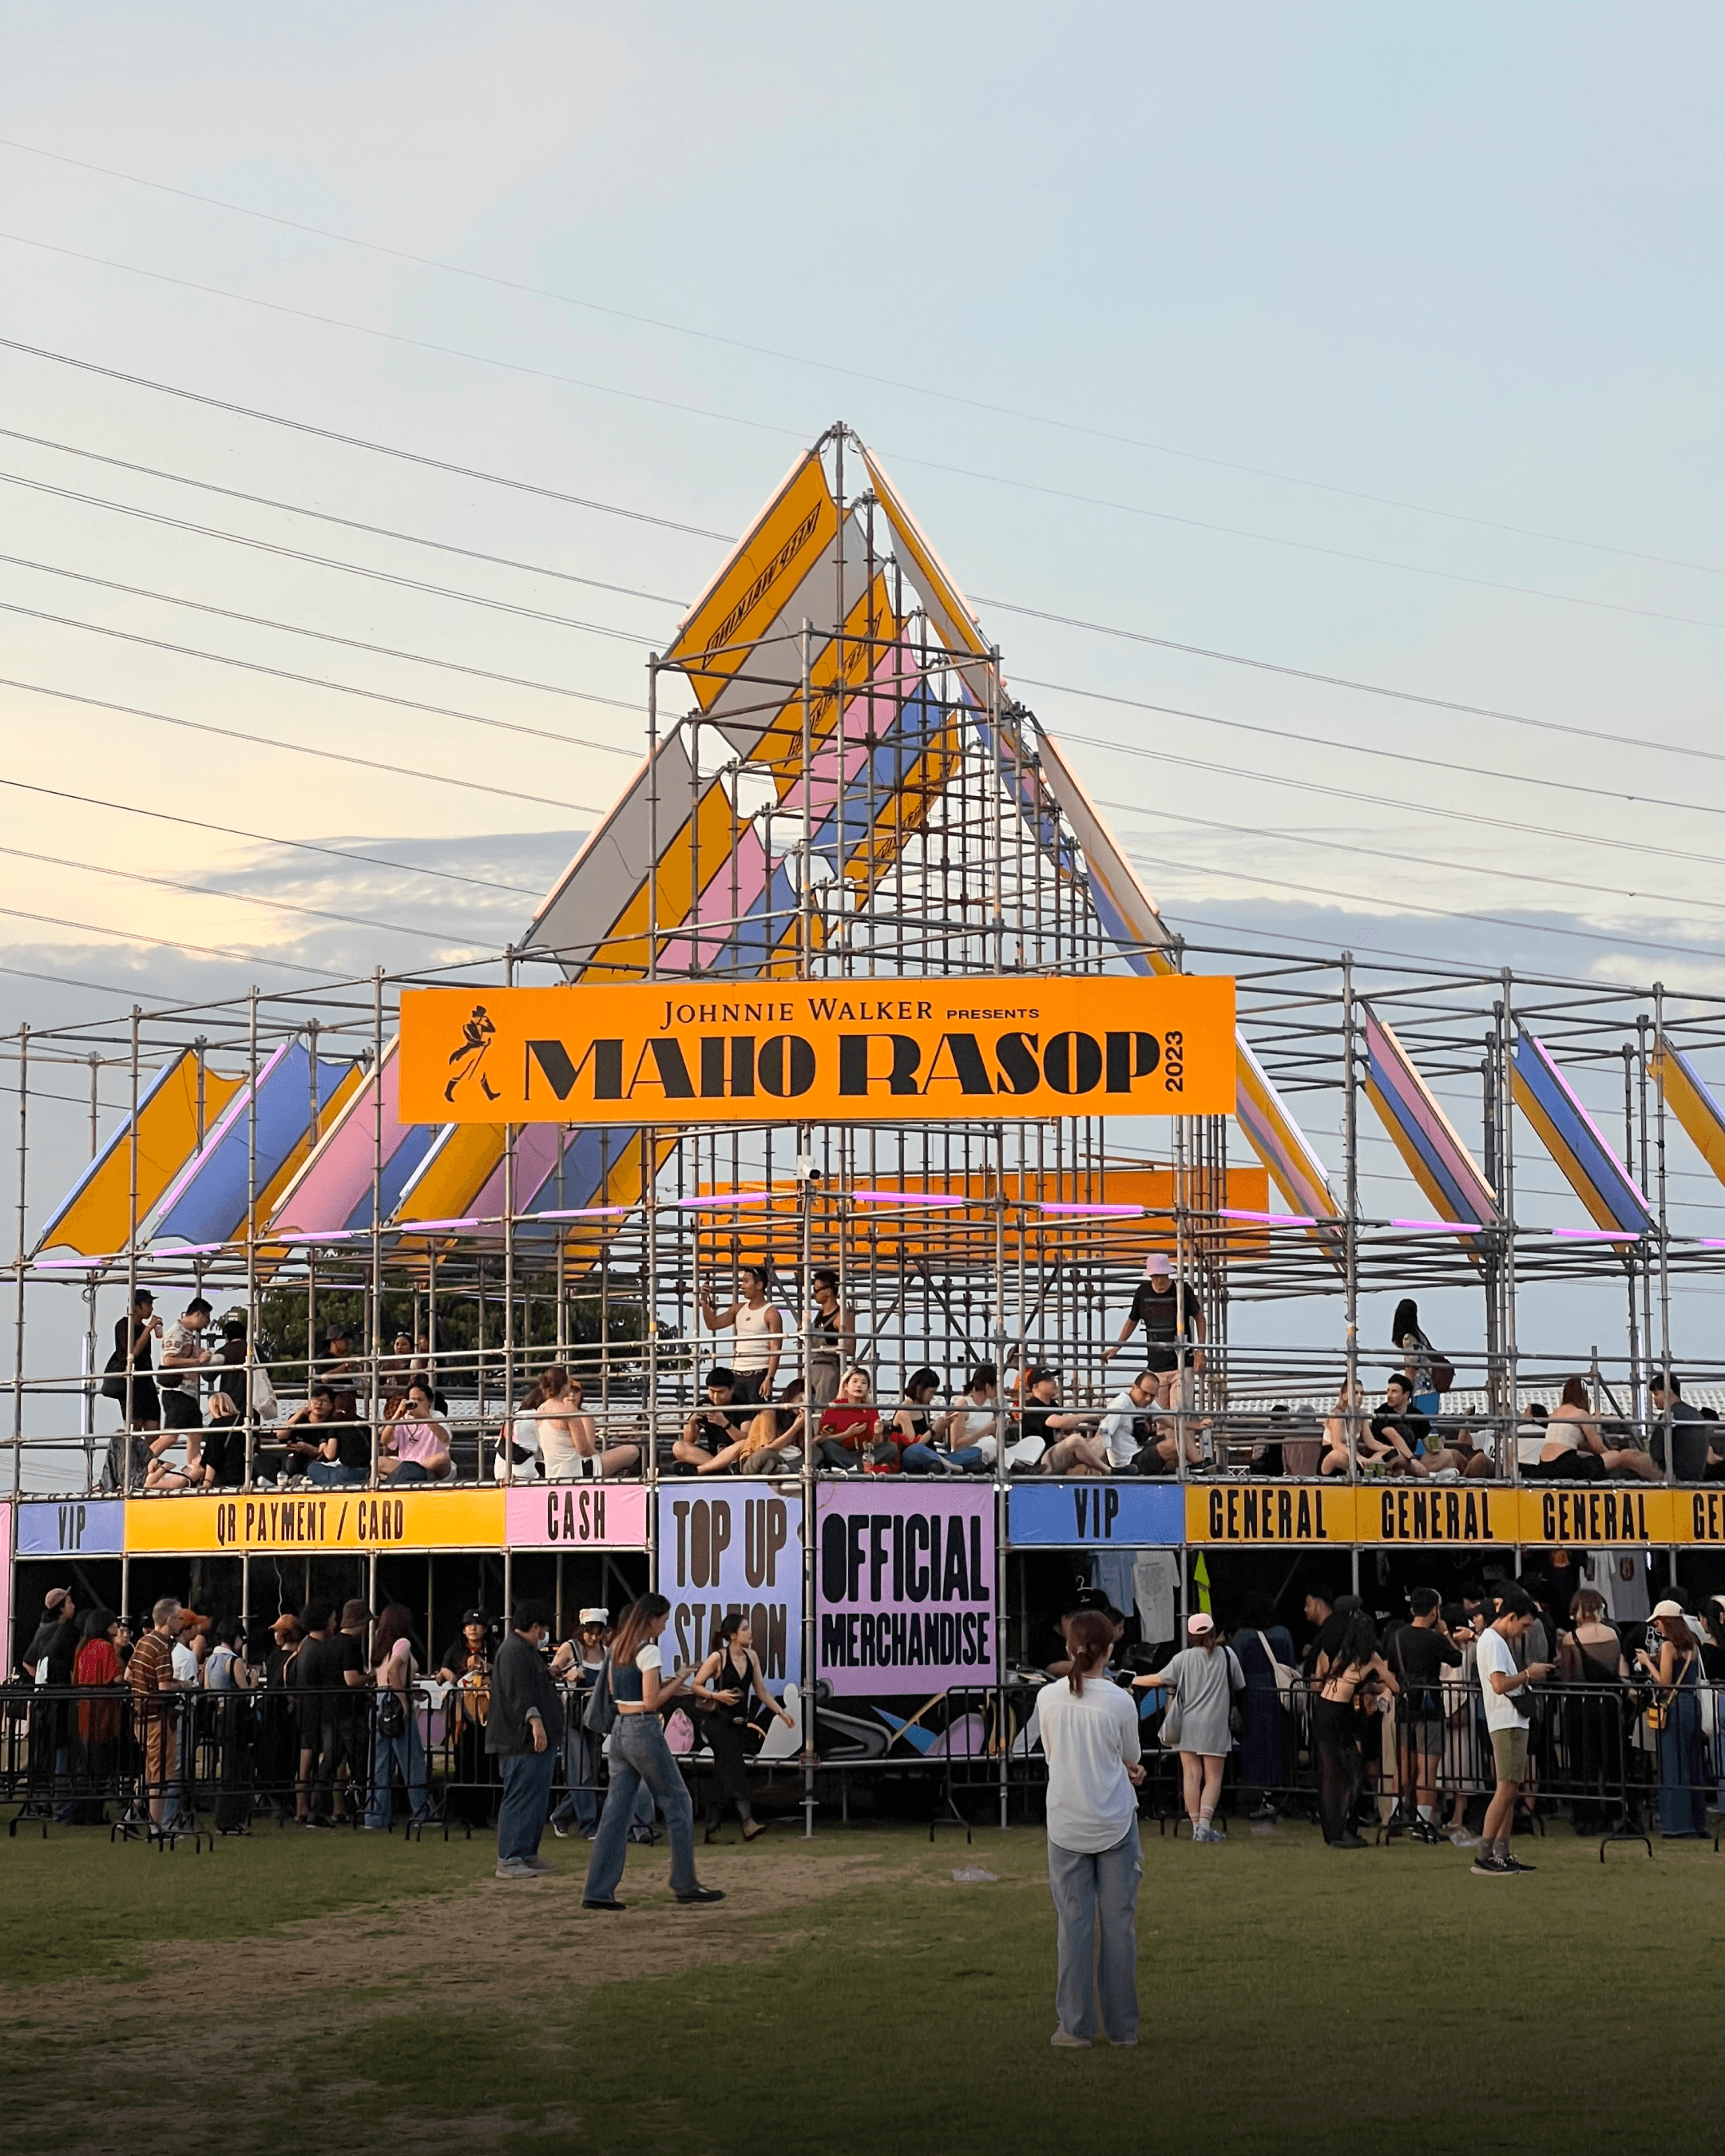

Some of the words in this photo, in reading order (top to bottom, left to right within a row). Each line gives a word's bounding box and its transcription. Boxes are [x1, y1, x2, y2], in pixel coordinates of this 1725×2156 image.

[947, 1009, 1039, 1020] PRESENTS
[524, 1035, 816, 1101] MAHO
[838, 1031, 1160, 1096] RASOP
[1165, 1030, 1184, 1092] 2023
[58, 1505, 86, 1550] VIP
[217, 1504, 236, 1546] QR
[246, 1500, 326, 1541] PAYMENT
[337, 1502, 347, 1540] /
[359, 1500, 403, 1540] CARD
[547, 1491, 605, 1541] CASH
[1074, 1488, 1118, 1539] VIP
[1209, 1489, 1327, 1540] GENERAL
[1381, 1490, 1493, 1540] GENERAL
[1543, 1492, 1649, 1540] GENERAL
[1693, 1492, 1725, 1540] GE
[673, 1499, 731, 1588] TOP
[745, 1499, 787, 1588] UP
[822, 1513, 990, 1603] OFFICIAL
[674, 1602, 787, 1680] STAON
[822, 1611, 991, 1667] MERCHANDISE
